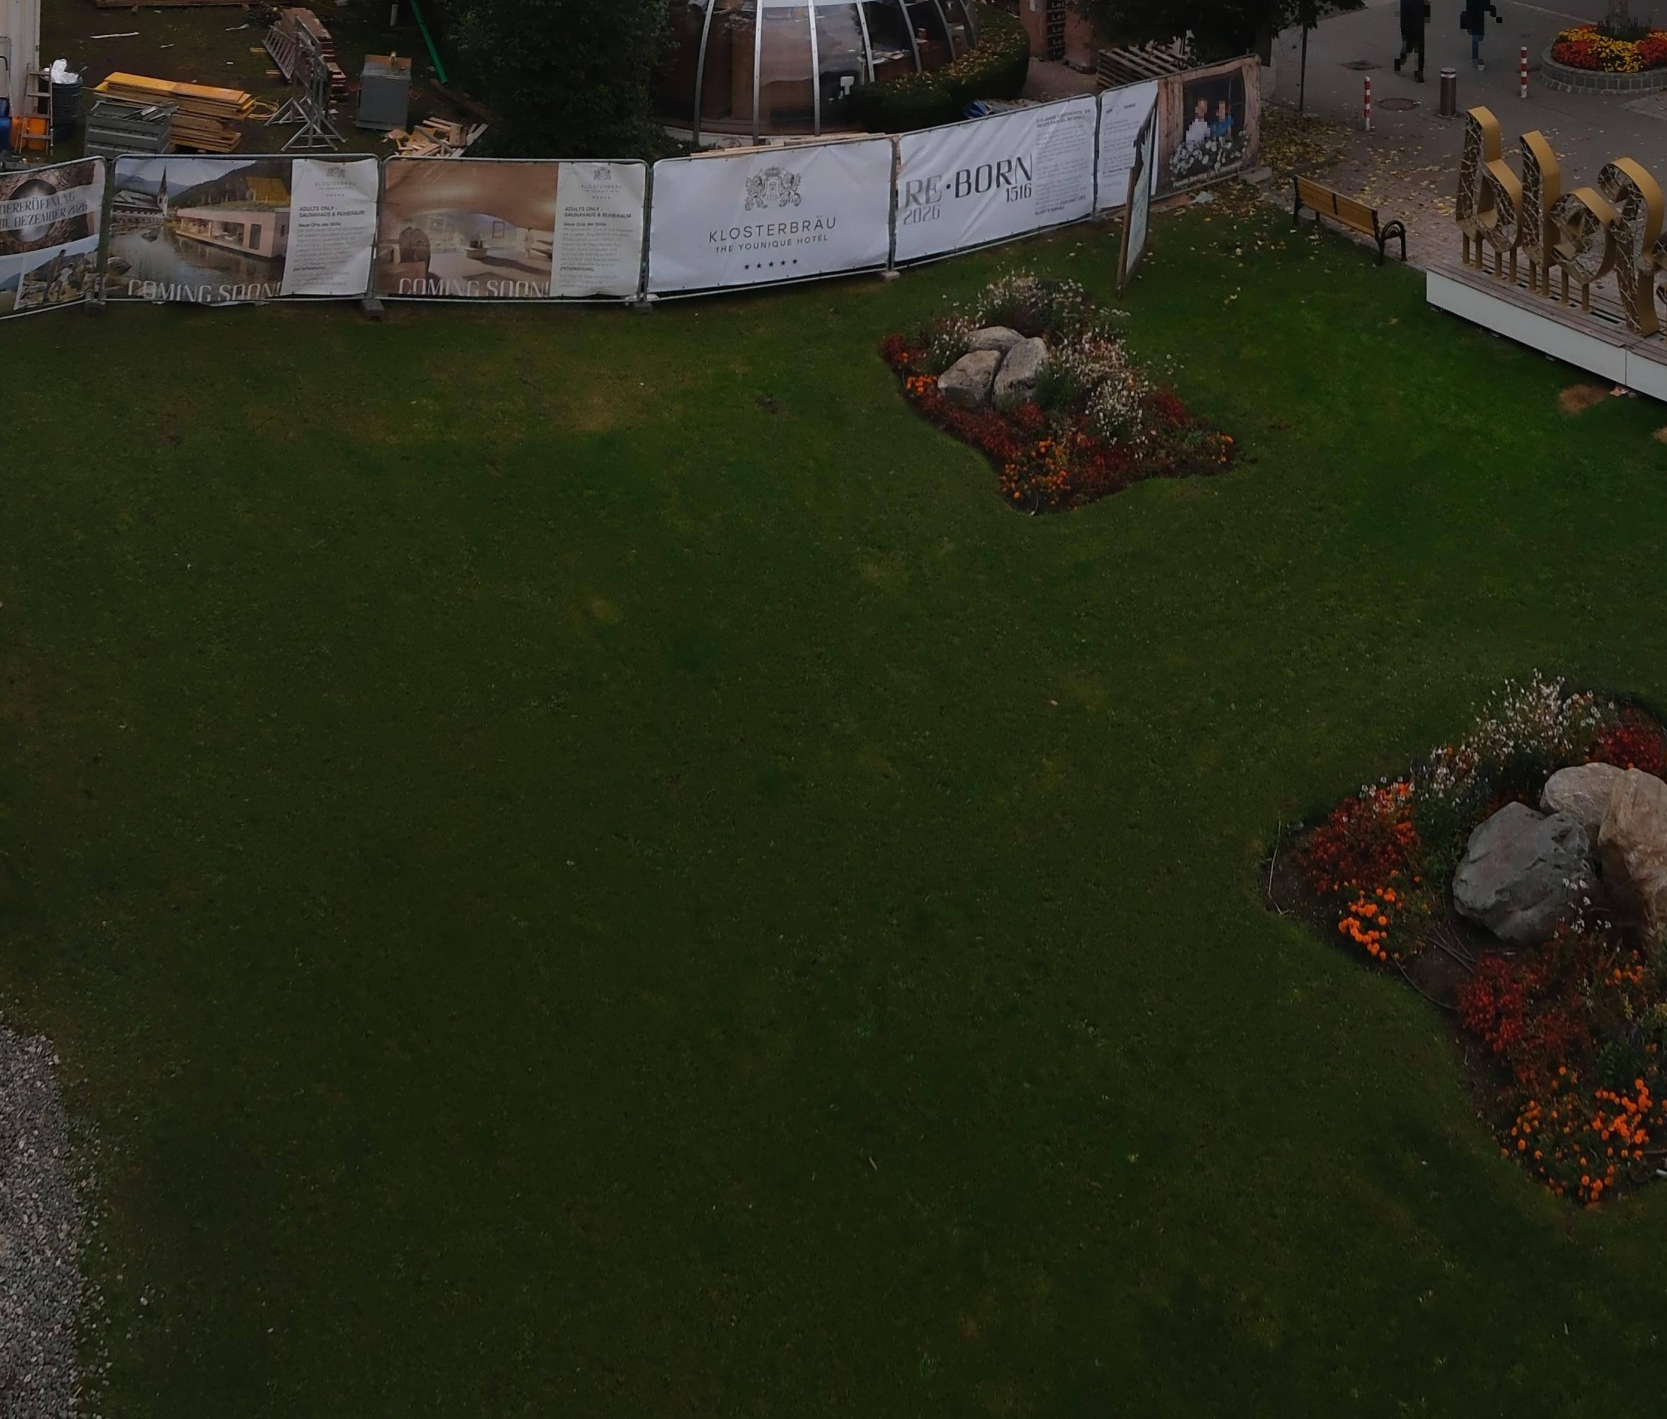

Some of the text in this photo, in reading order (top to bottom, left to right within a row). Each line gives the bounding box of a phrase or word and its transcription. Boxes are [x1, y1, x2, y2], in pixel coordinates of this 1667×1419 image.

[1006, 182, 1033, 203] 1516
[903, 205, 941, 225] 2026
[709, 216, 836, 243] KLOSTERBRÄU
[715, 234, 828, 254] THE YOUNIQUE HOTEL
